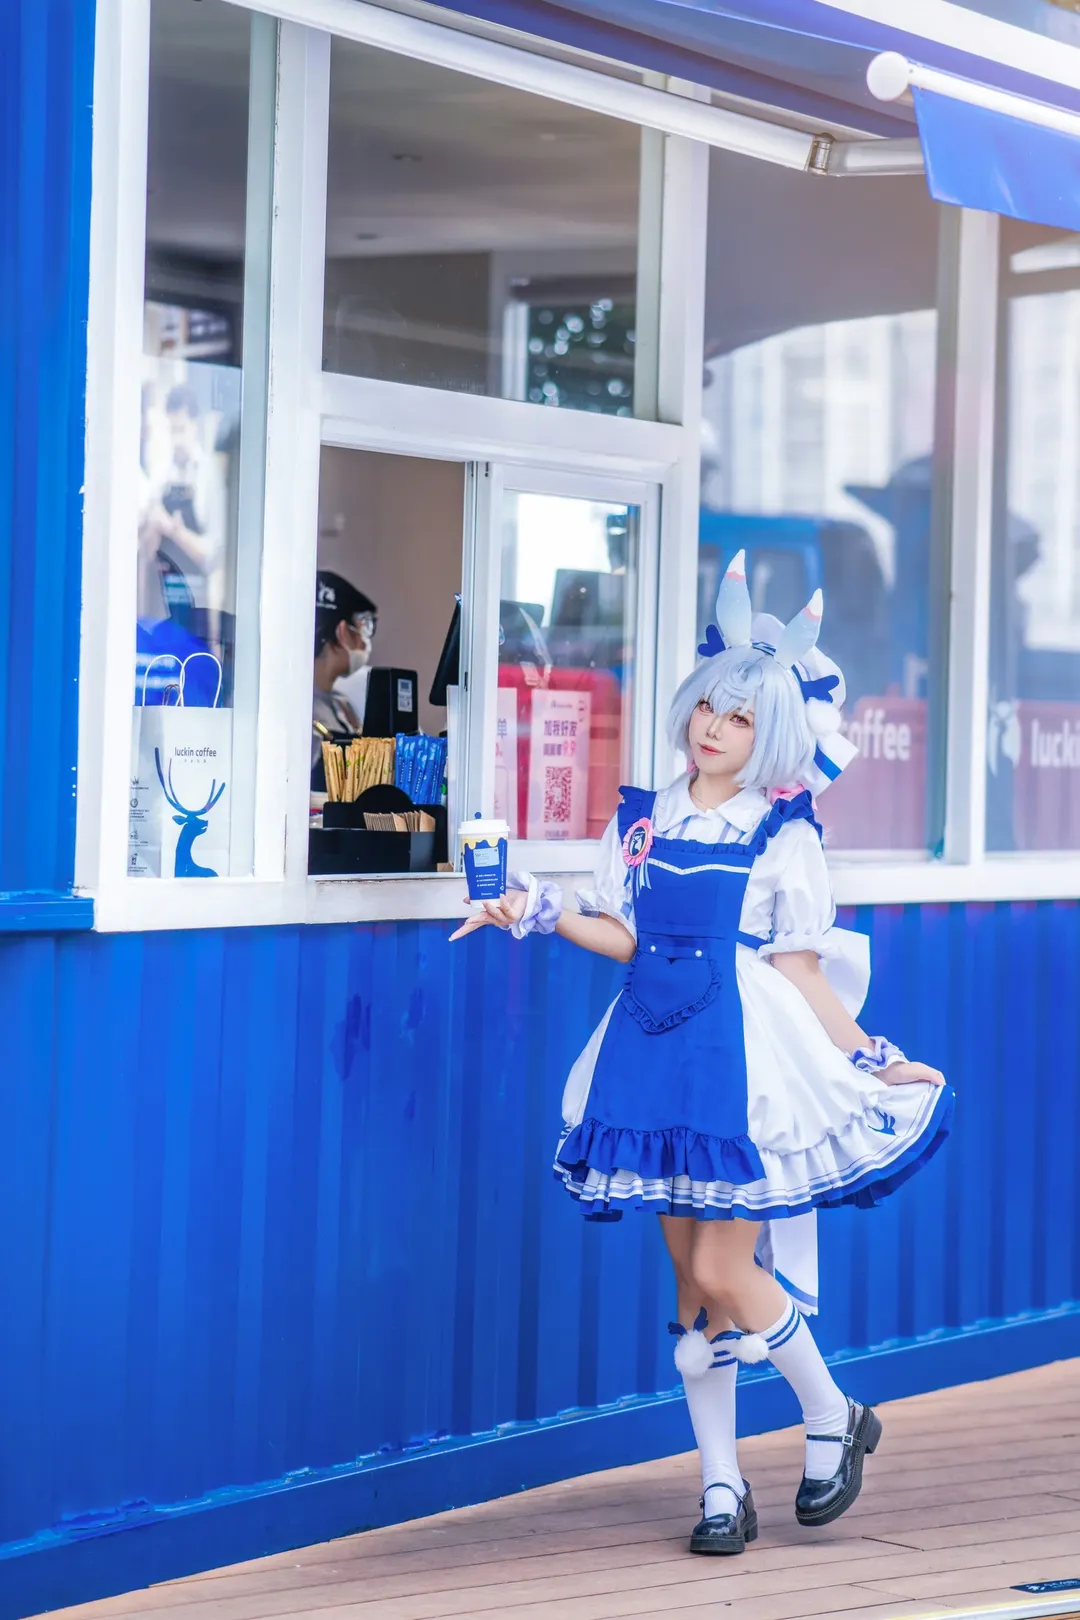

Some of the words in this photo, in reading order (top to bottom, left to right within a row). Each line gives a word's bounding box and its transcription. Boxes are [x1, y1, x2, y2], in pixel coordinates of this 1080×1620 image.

[838, 707, 911, 761] offee
[174, 746, 194, 757] luckin
[195, 746, 217, 757] coffee
